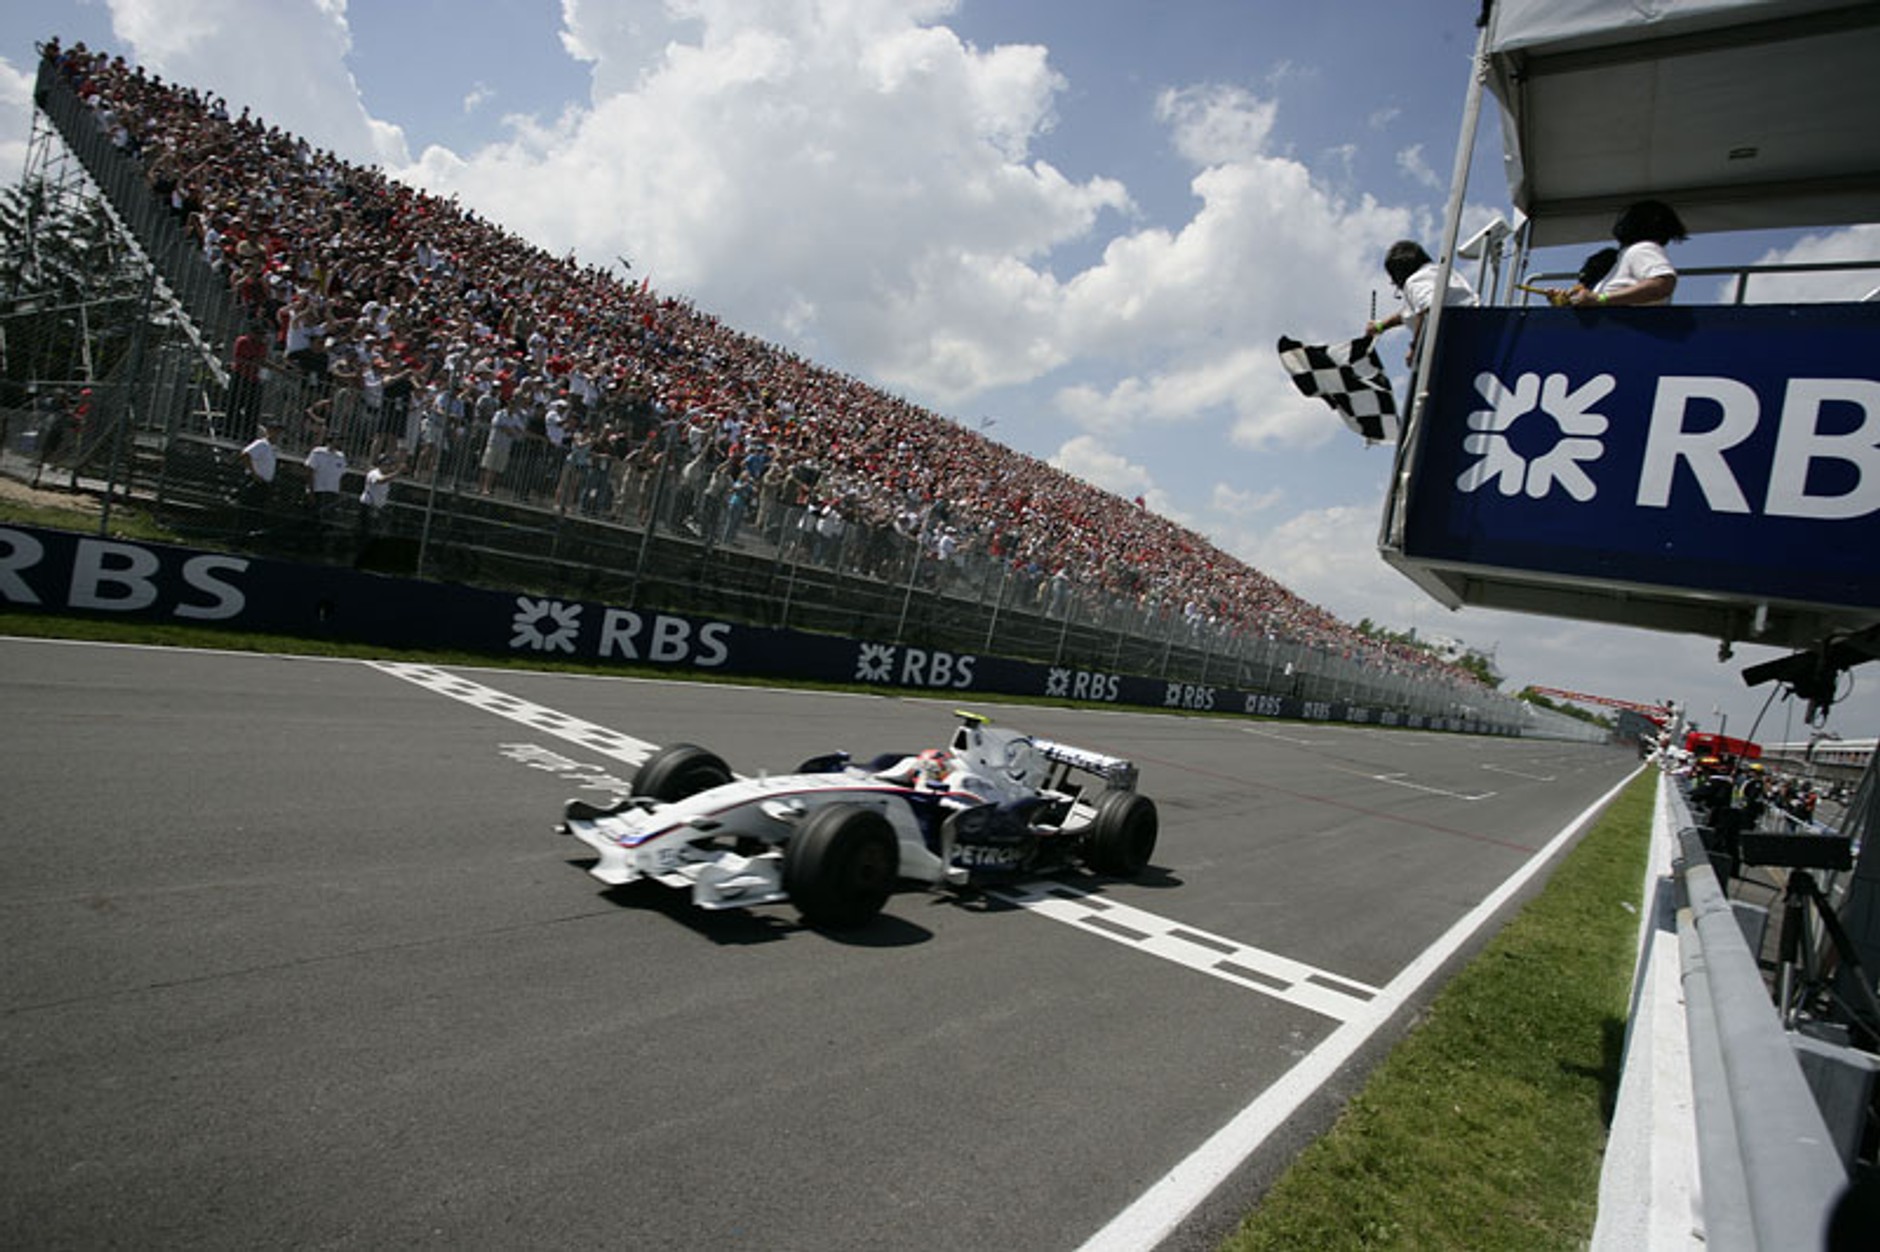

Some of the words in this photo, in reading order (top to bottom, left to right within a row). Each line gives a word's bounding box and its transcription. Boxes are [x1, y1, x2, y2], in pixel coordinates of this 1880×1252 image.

[598, 608, 731, 666] RBS
[901, 649, 976, 688] RBS
[1073, 672, 1120, 700] RBS
[1182, 686, 1216, 710] RBS
